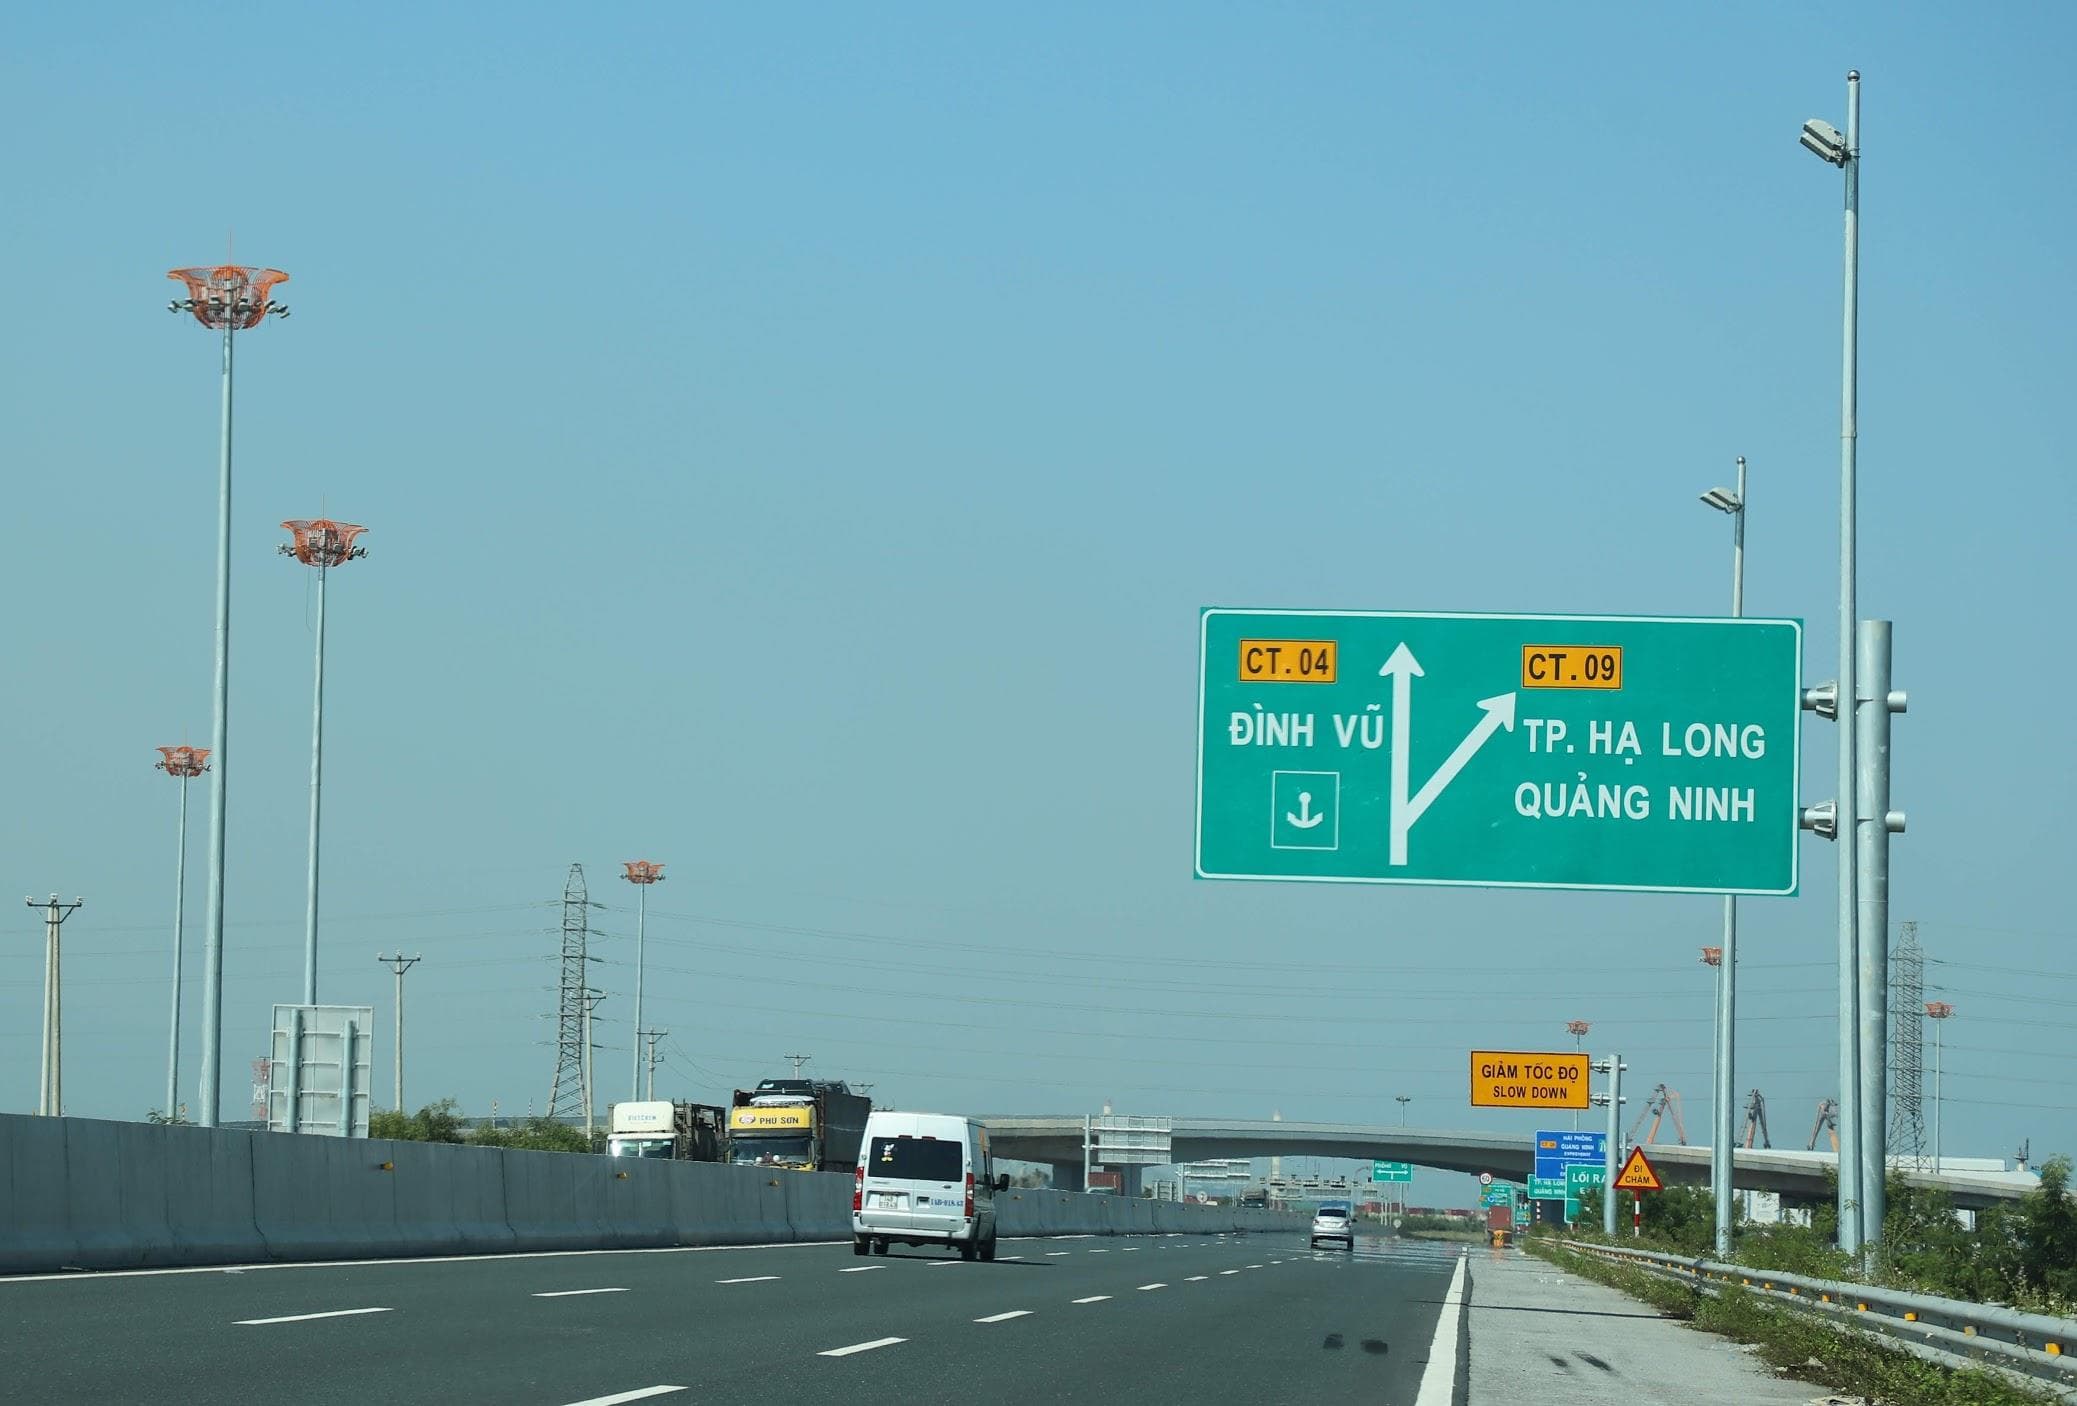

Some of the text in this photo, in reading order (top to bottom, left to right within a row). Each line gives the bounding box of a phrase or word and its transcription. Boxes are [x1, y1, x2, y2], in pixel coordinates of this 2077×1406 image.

[1246, 647, 1329, 675] CT.04
[1528, 653, 1615, 680] CT.09
[1228, 702, 1384, 749] ĐÌNH VŨ
[1523, 719, 1765, 765] TP. HẠ LONG
[1514, 771, 1755, 822] QUẢNG NINH
[1481, 1060, 1579, 1084] GIẢM TỐC ĐỘ
[1493, 1085, 1567, 1099] SLOW DOWN
[1572, 1170, 1589, 1183] LỐI
[1634, 1165, 1643, 1173] ĐI
